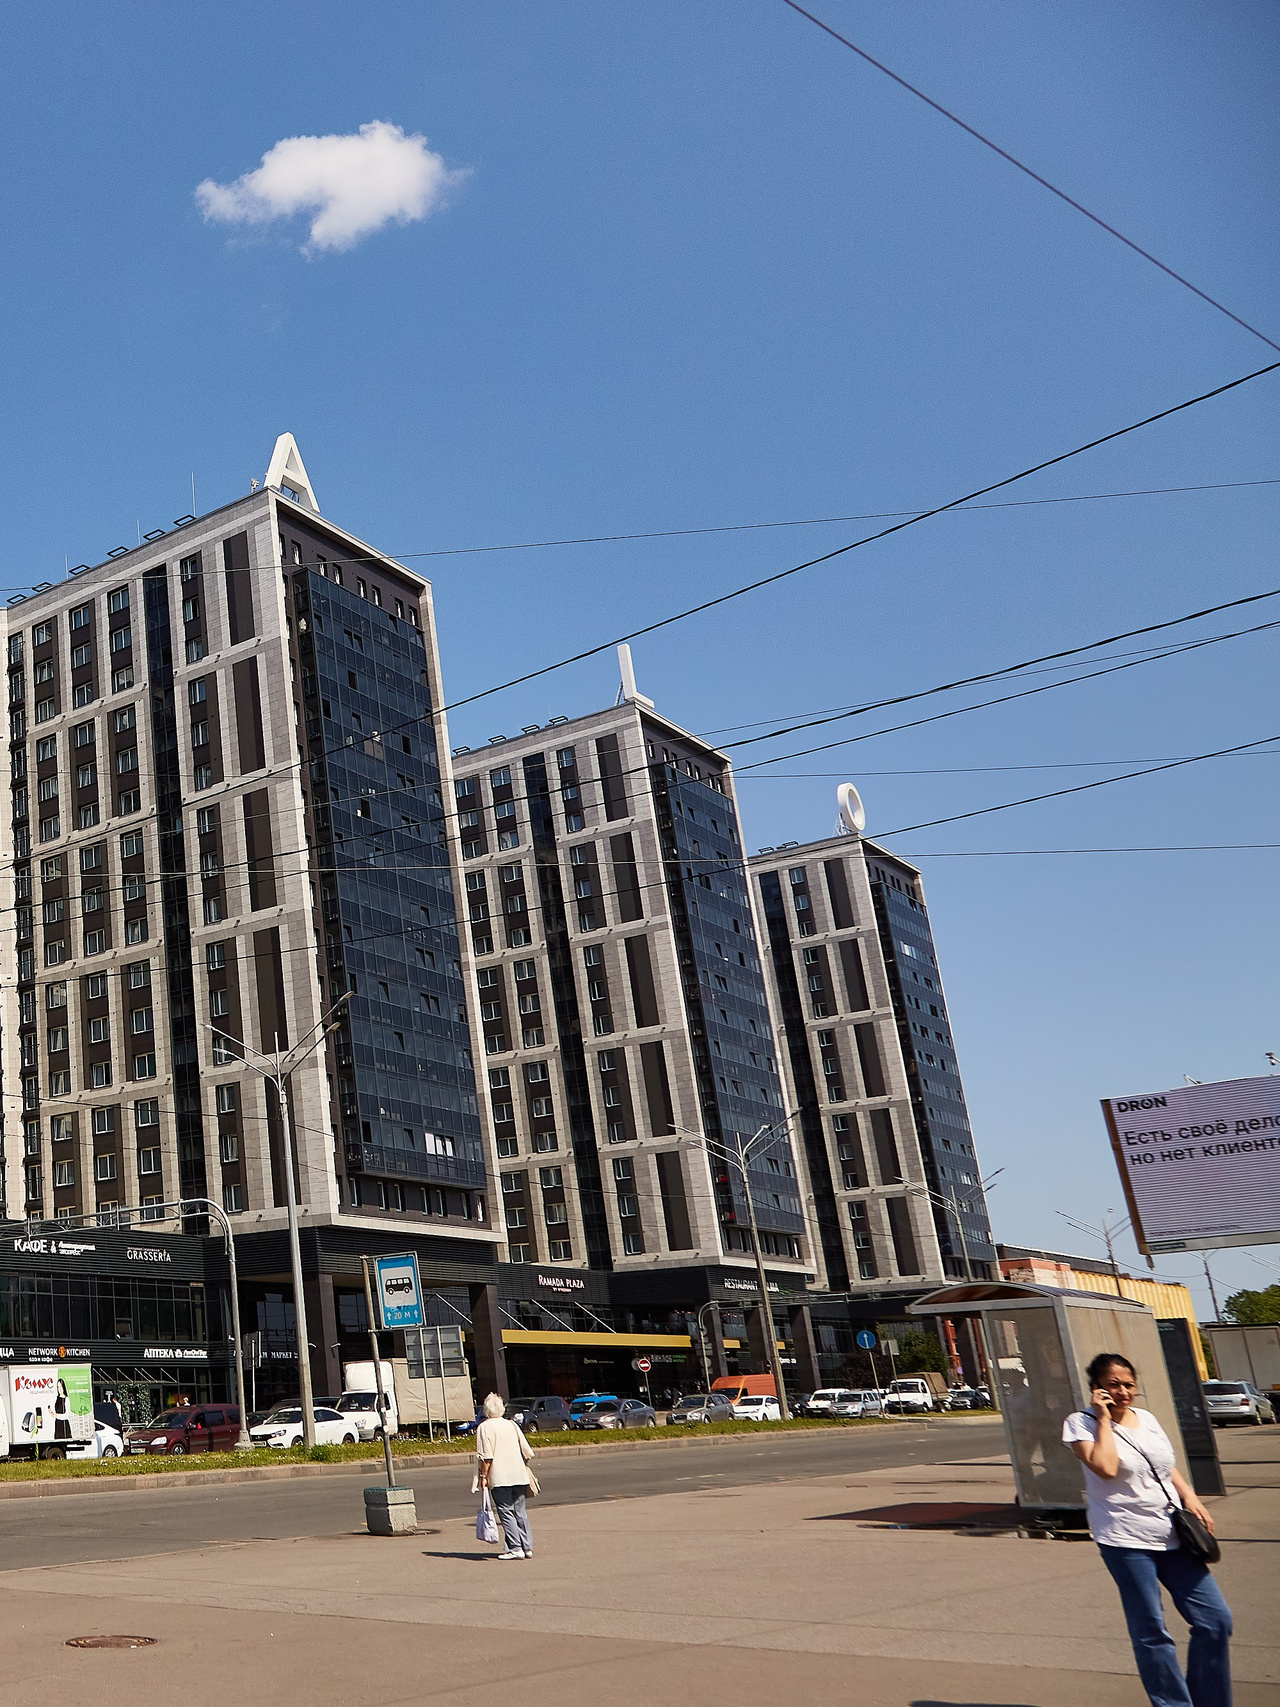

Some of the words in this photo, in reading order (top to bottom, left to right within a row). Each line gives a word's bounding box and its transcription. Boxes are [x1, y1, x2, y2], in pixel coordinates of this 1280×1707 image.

[263, 431, 321, 513] A
[1116, 1096, 1168, 1113] DRON
[1123, 1129, 1173, 1147] Есть
[1177, 1119, 1229, 1140] своё
[1130, 1152, 1155, 1166] но
[1160, 1146, 1197, 1162] нет
[1203, 1137, 1280, 1157] клиент
[13, 1238, 49, 1254] КАФЕ
[126, 1248, 172, 1262] GRASSERIA
[393, 1312, 403, 1320] 20
[28, 1347, 58, 1356] NETWORK
[66, 1348, 91, 1357] KITCHEN
[143, 1348, 175, 1359] АПТЕКА
